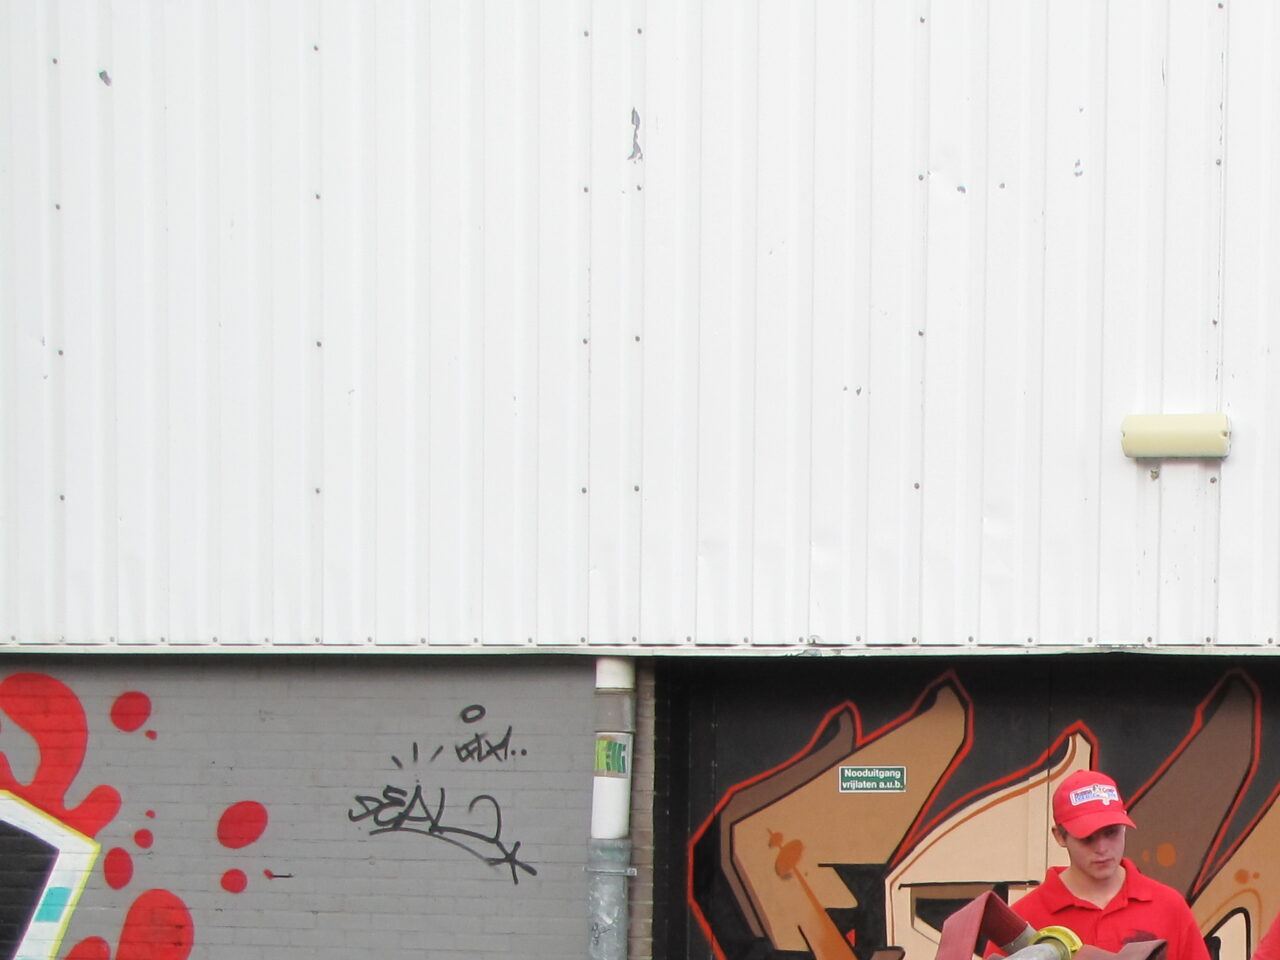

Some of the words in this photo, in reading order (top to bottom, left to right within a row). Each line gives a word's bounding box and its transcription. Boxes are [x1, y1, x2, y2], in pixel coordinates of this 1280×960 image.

[844, 768, 901, 779] Nooduitgang
[842, 780, 878, 790] vrijlaten
[879, 780, 904, 789] a.u.b.
